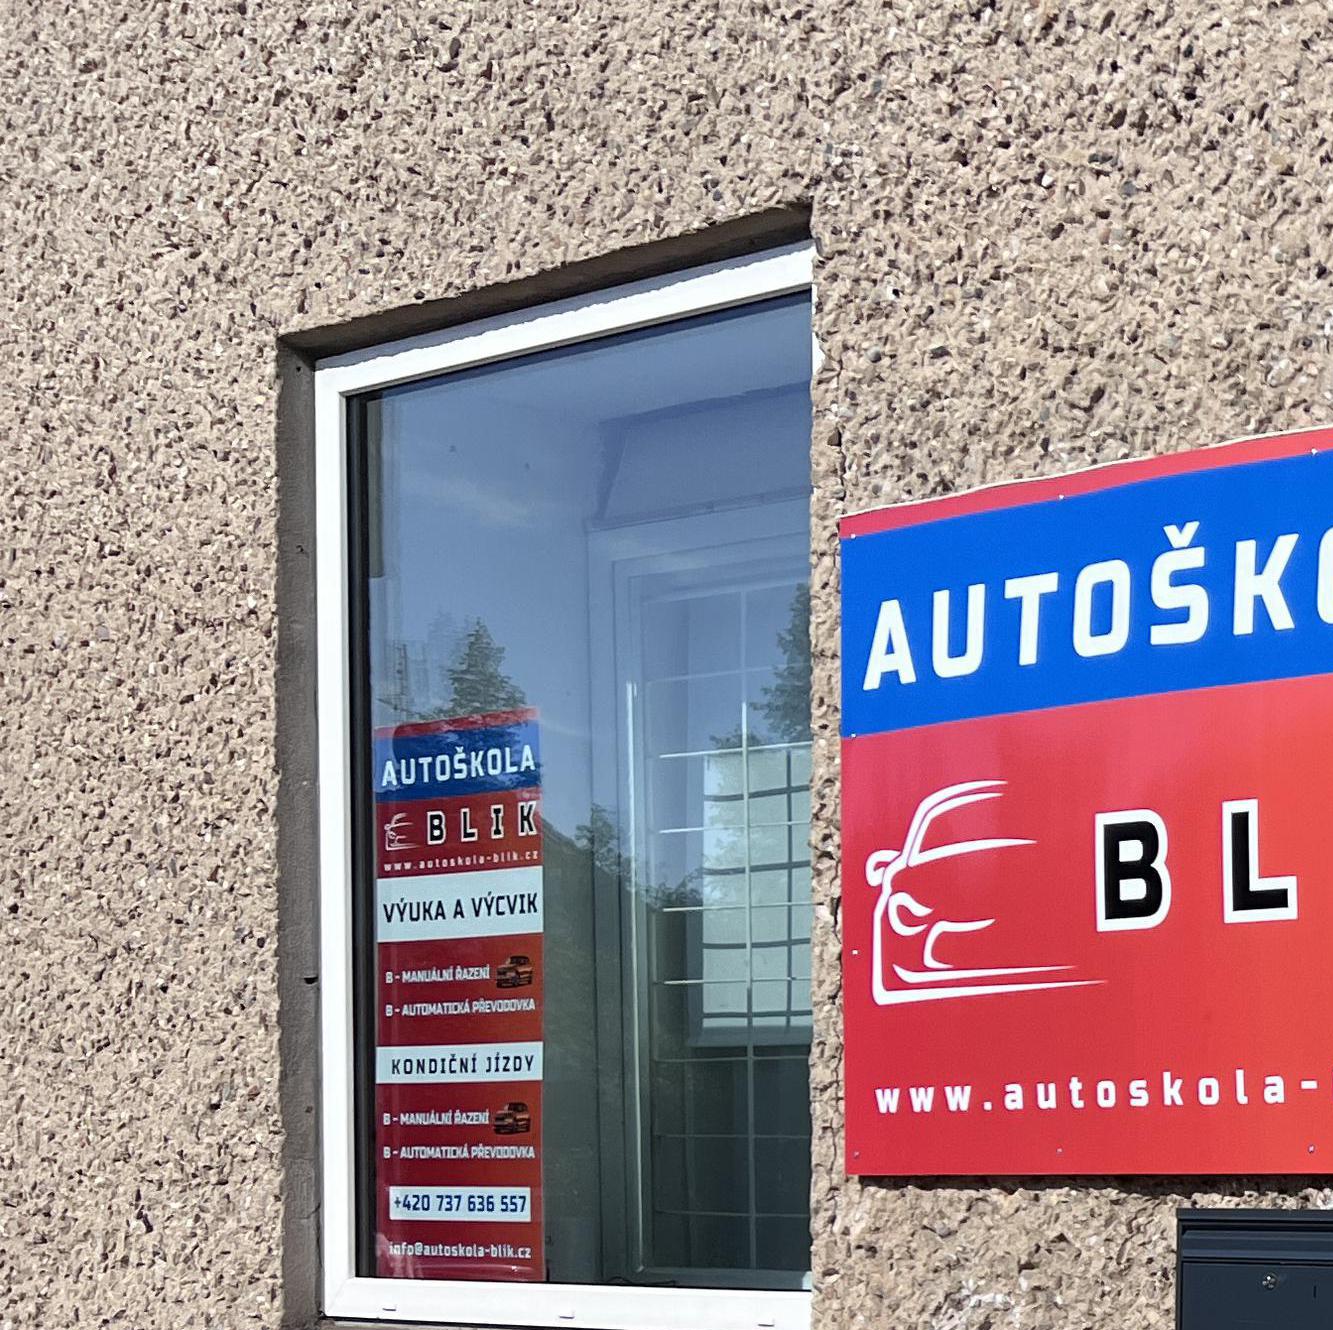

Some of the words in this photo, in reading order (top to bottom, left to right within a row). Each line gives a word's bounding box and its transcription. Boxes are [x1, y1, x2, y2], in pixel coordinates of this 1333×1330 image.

[381, 745, 536, 787] AUTOŠKOLA
[426, 801, 539, 845] BLIK
[383, 850, 540, 872] www.autoskola-blik.cz
[383, 897, 447, 923] VÝUKA
[453, 902, 465, 919] A
[471, 891, 538, 918] VÝCVIK
[402, 965, 453, 983] MANUÁLNÍ
[402, 999, 470, 1017] AUTOMATICKÁ
[391, 1053, 477, 1075] KONDIČNÍ
[485, 1052, 535, 1073] JÍZDY
[400, 1143, 469, 1159] AUTOMATICKÁ
[394, 1194, 431, 1211] +420
[436, 1194, 462, 1211] 737
[467, 1195, 495, 1212] 636
[500, 1195, 527, 1213] 557
[388, 1241, 531, 1259] info@autoskola-blik.cz
